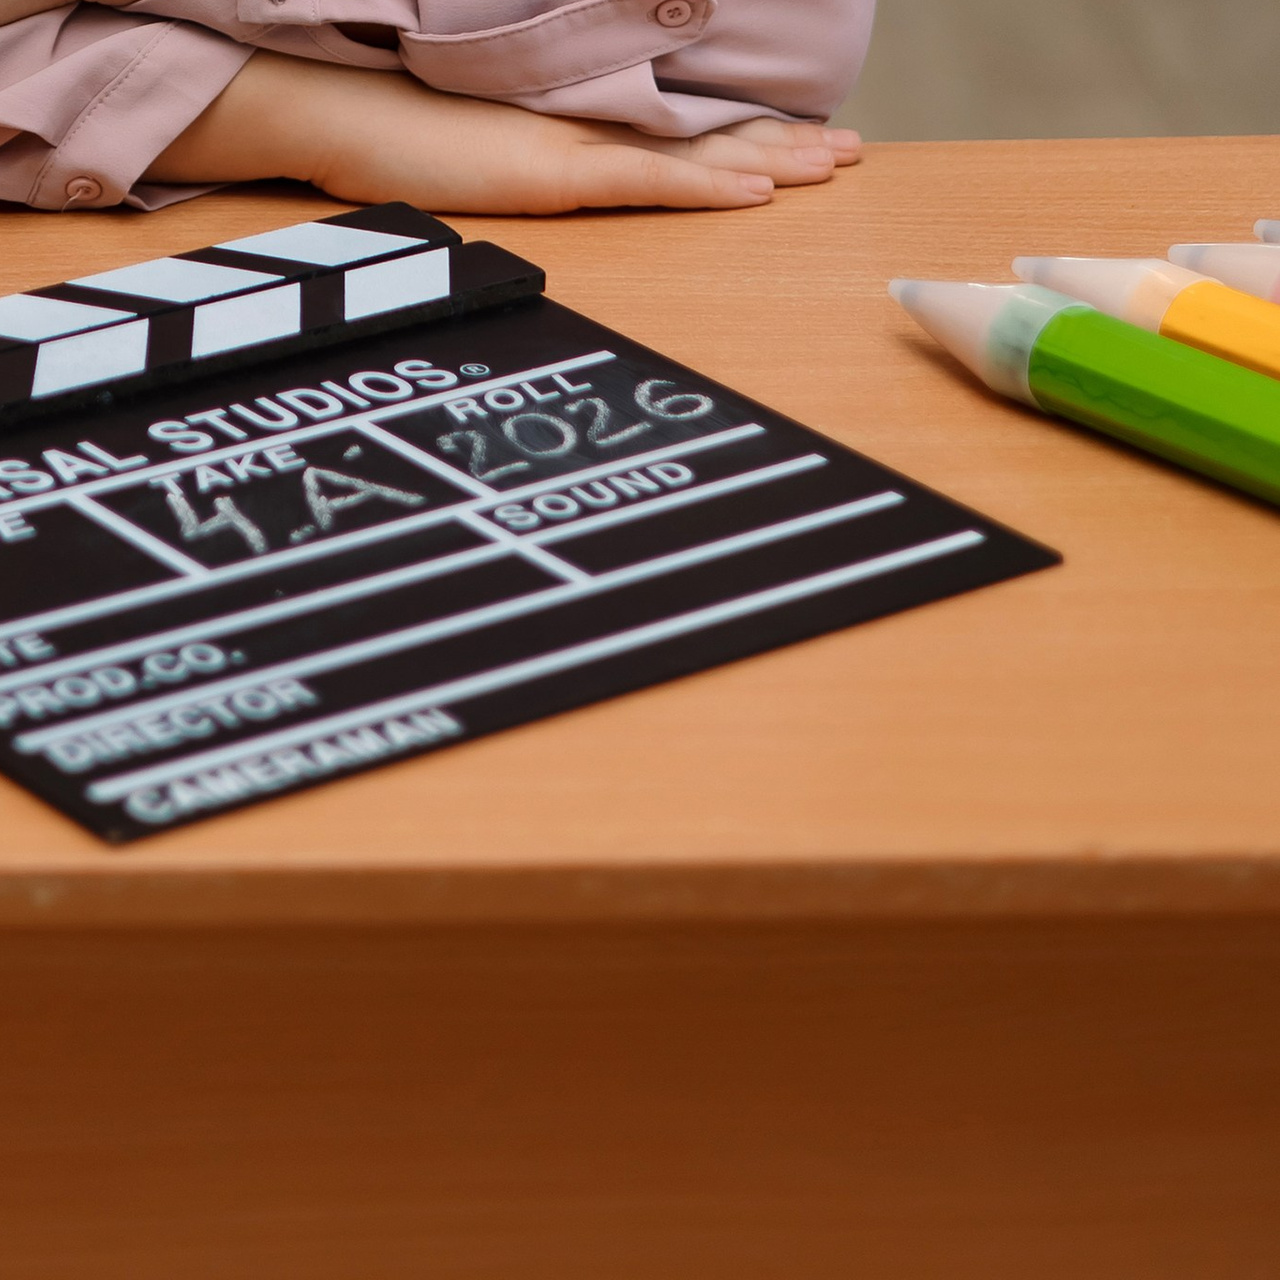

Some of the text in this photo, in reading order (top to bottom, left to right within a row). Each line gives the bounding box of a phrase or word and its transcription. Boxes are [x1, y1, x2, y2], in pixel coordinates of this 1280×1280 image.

[436, 378, 714, 480] 2026
[442, 372, 593, 425] ROLL
[148, 443, 308, 500] TAKE
[493, 461, 694, 529] SOUND
[44, 676, 320, 774] DIRECTOR
[124, 707, 465, 824] CAMERAMAN
